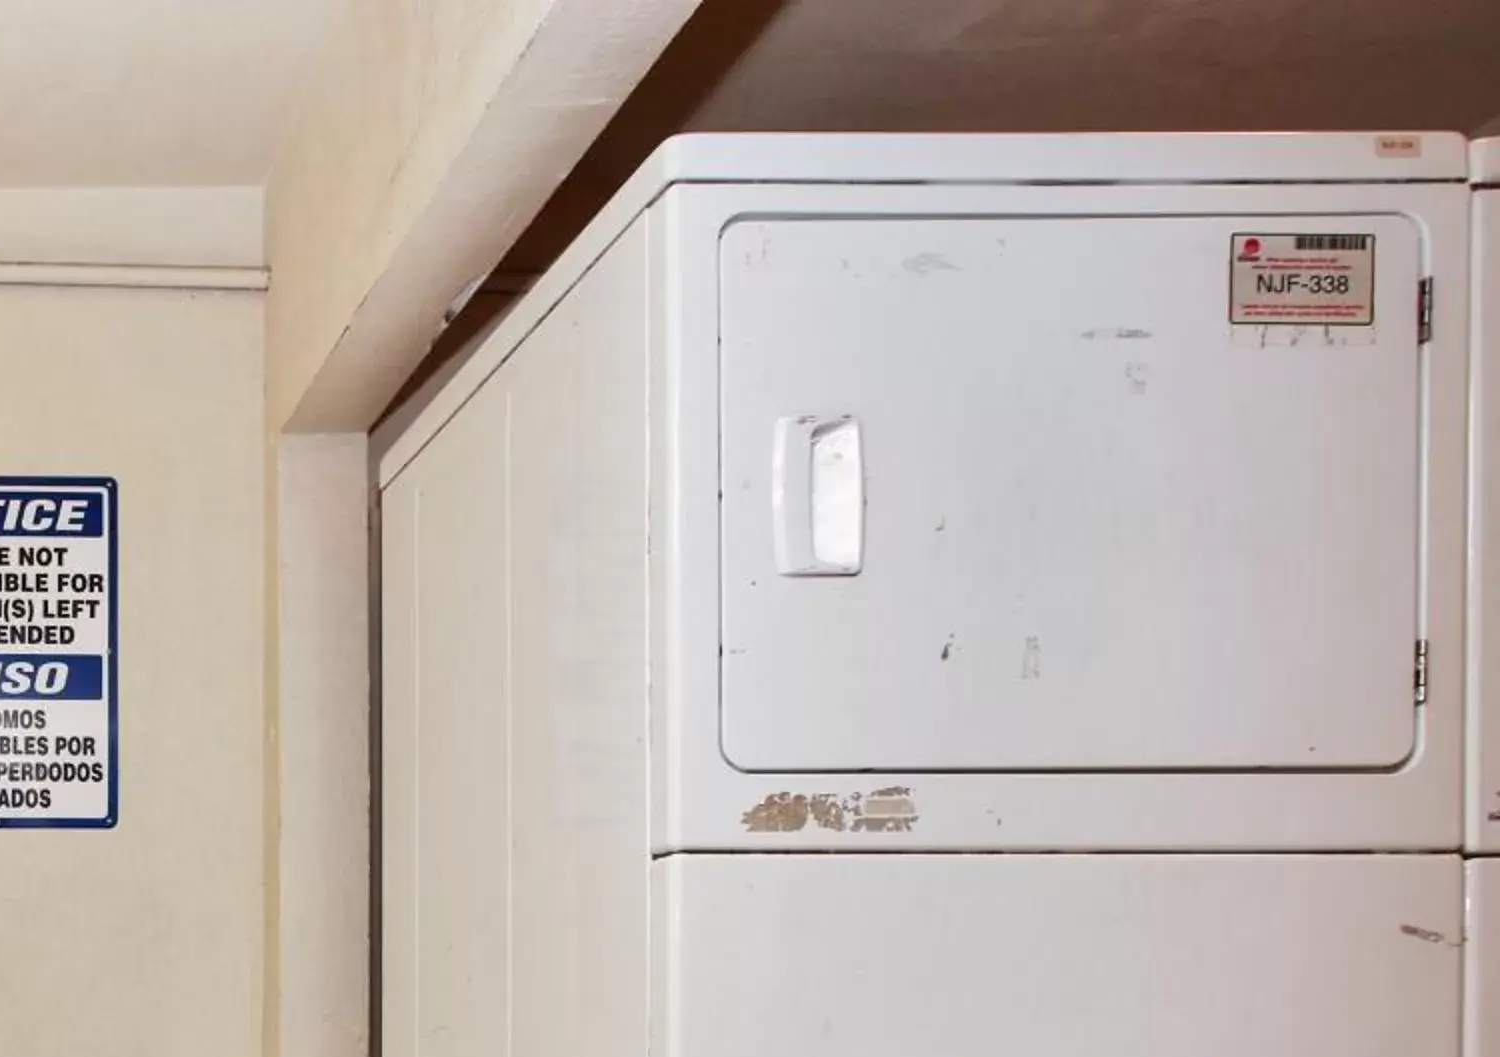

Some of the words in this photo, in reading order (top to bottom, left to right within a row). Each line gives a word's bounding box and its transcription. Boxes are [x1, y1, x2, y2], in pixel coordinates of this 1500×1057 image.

[1257, 274, 1349, 293] NJF-338
[19, 547, 68, 565] NOT
[58, 573, 104, 592] FOR
[43, 599, 100, 618] LEFT
[55, 736, 96, 755] POR
